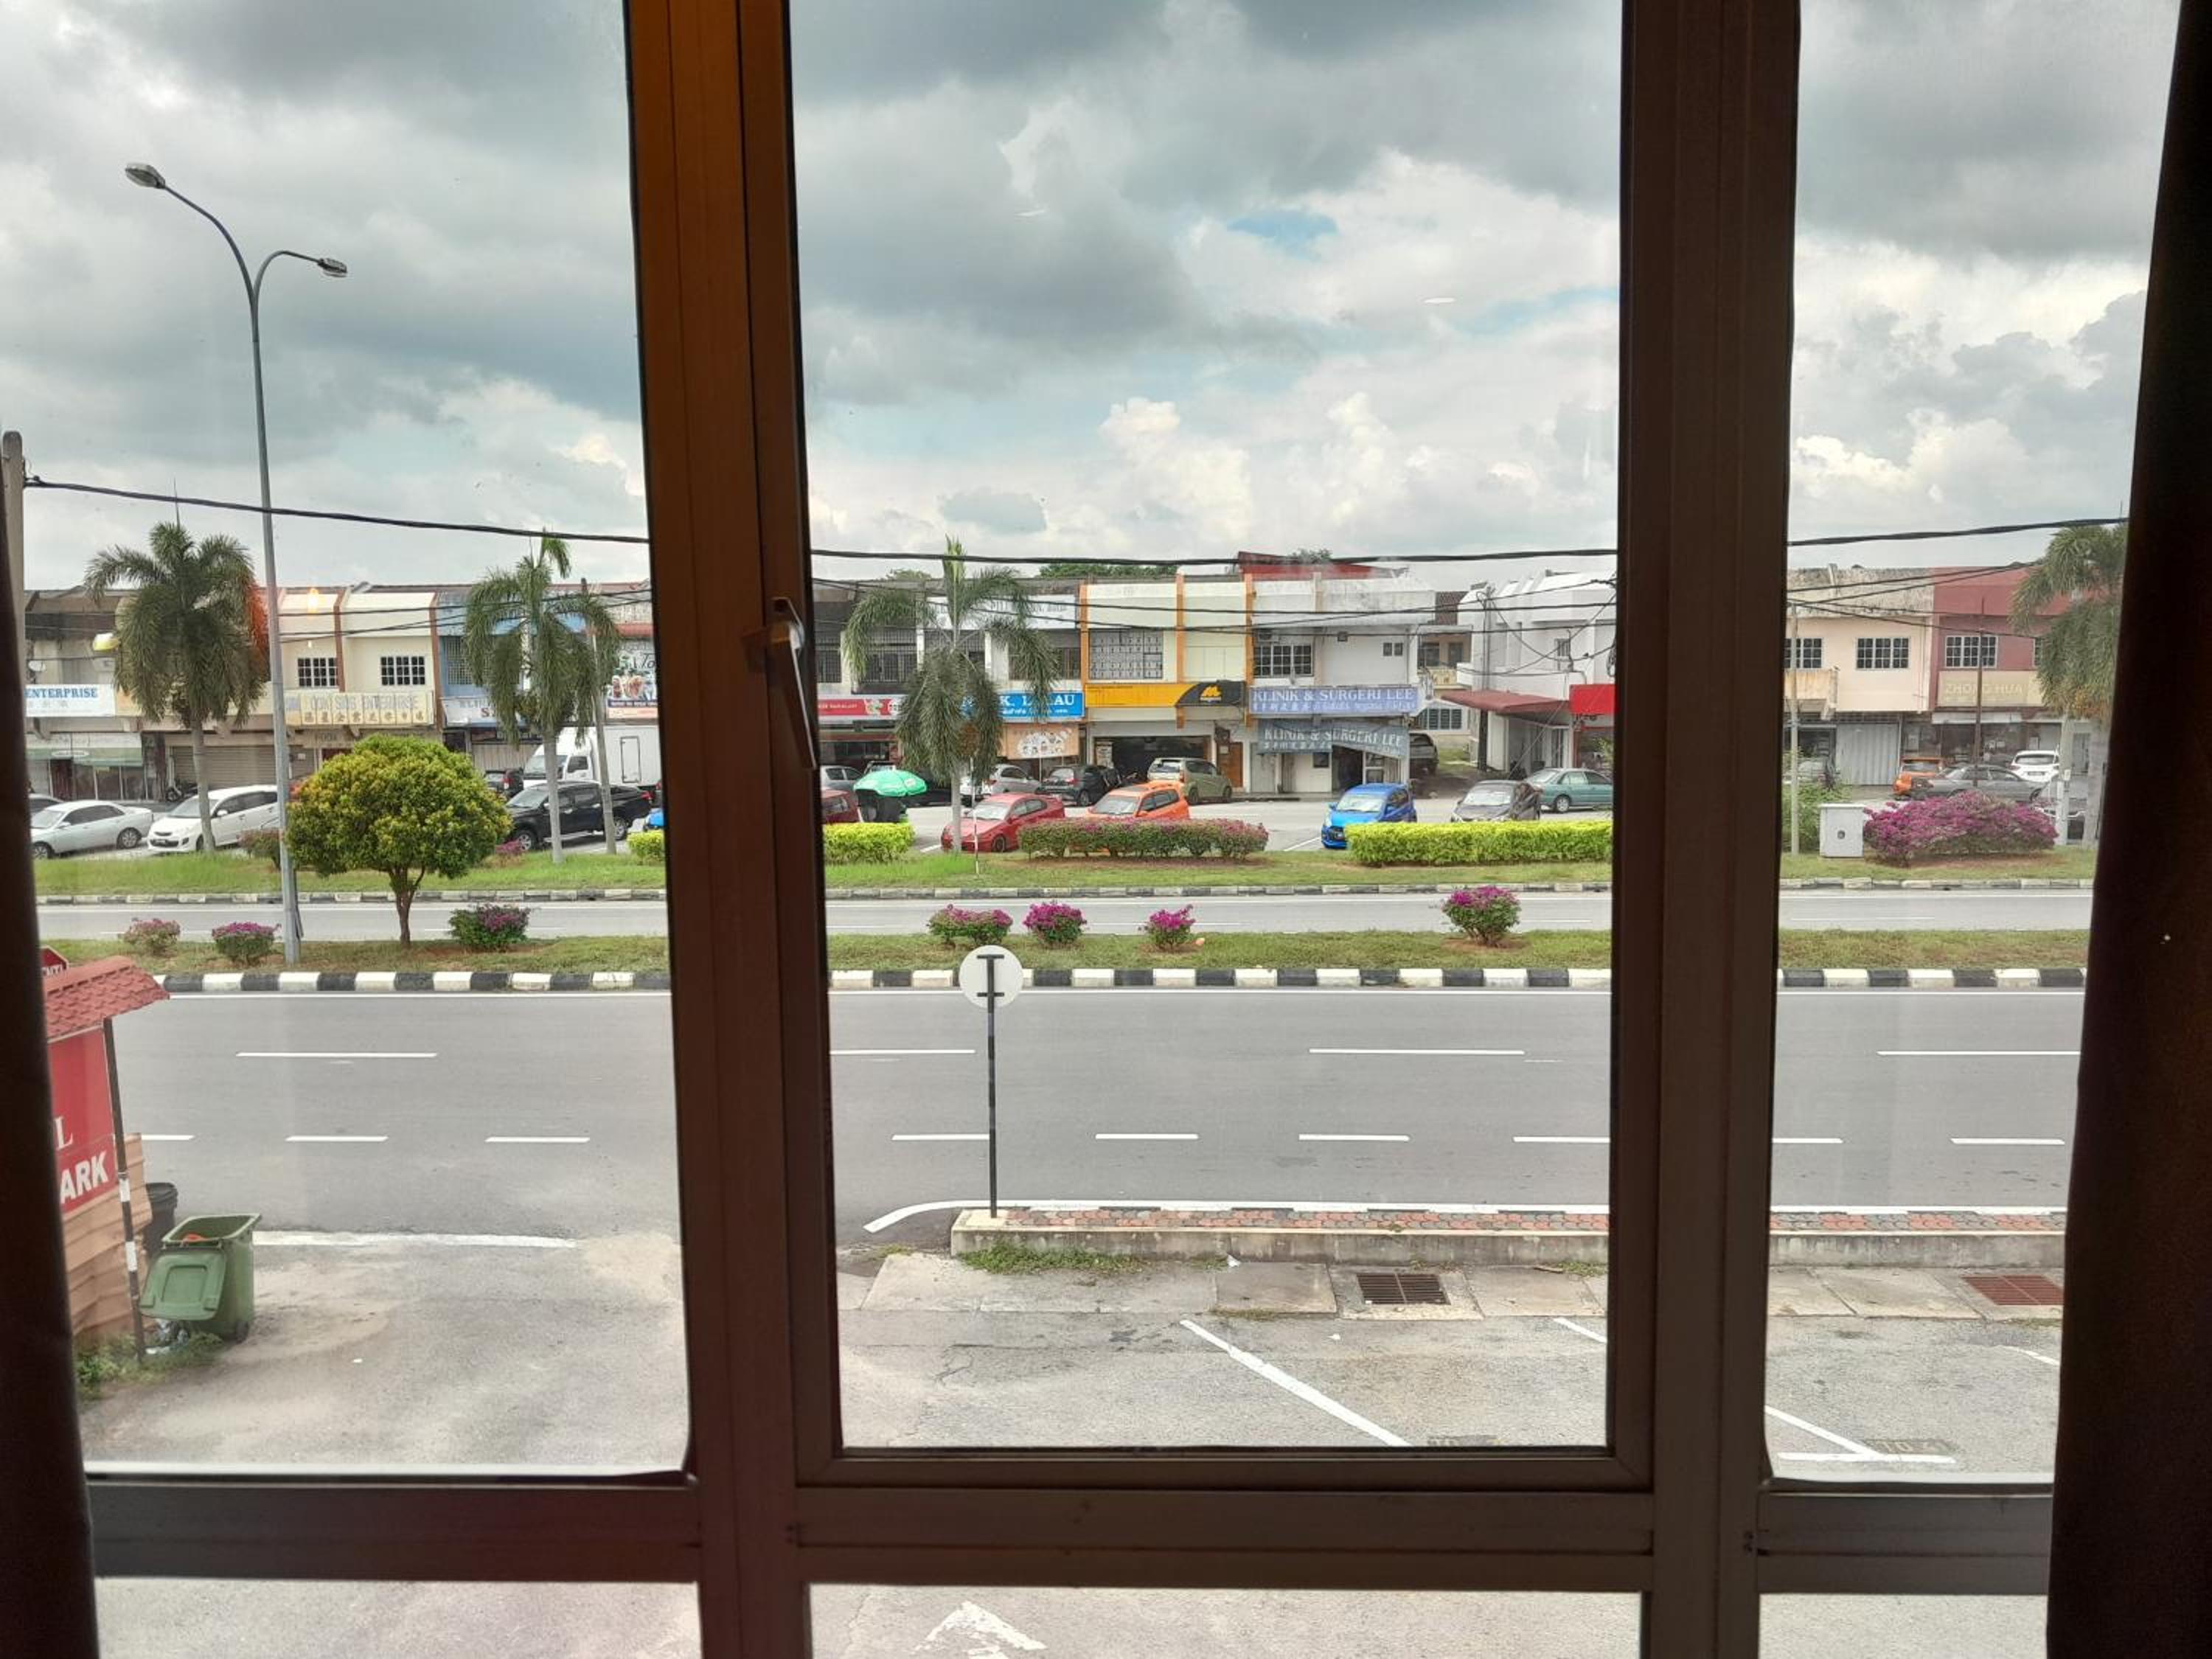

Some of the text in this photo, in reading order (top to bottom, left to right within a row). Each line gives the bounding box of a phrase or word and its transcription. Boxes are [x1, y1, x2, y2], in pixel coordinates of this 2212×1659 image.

[1254, 689, 1413, 701] KLINIK & SURGERI LEE
[1264, 728, 1402, 747] KLINIK & SURGERI LEE
[60, 1150, 109, 1204] ARK
